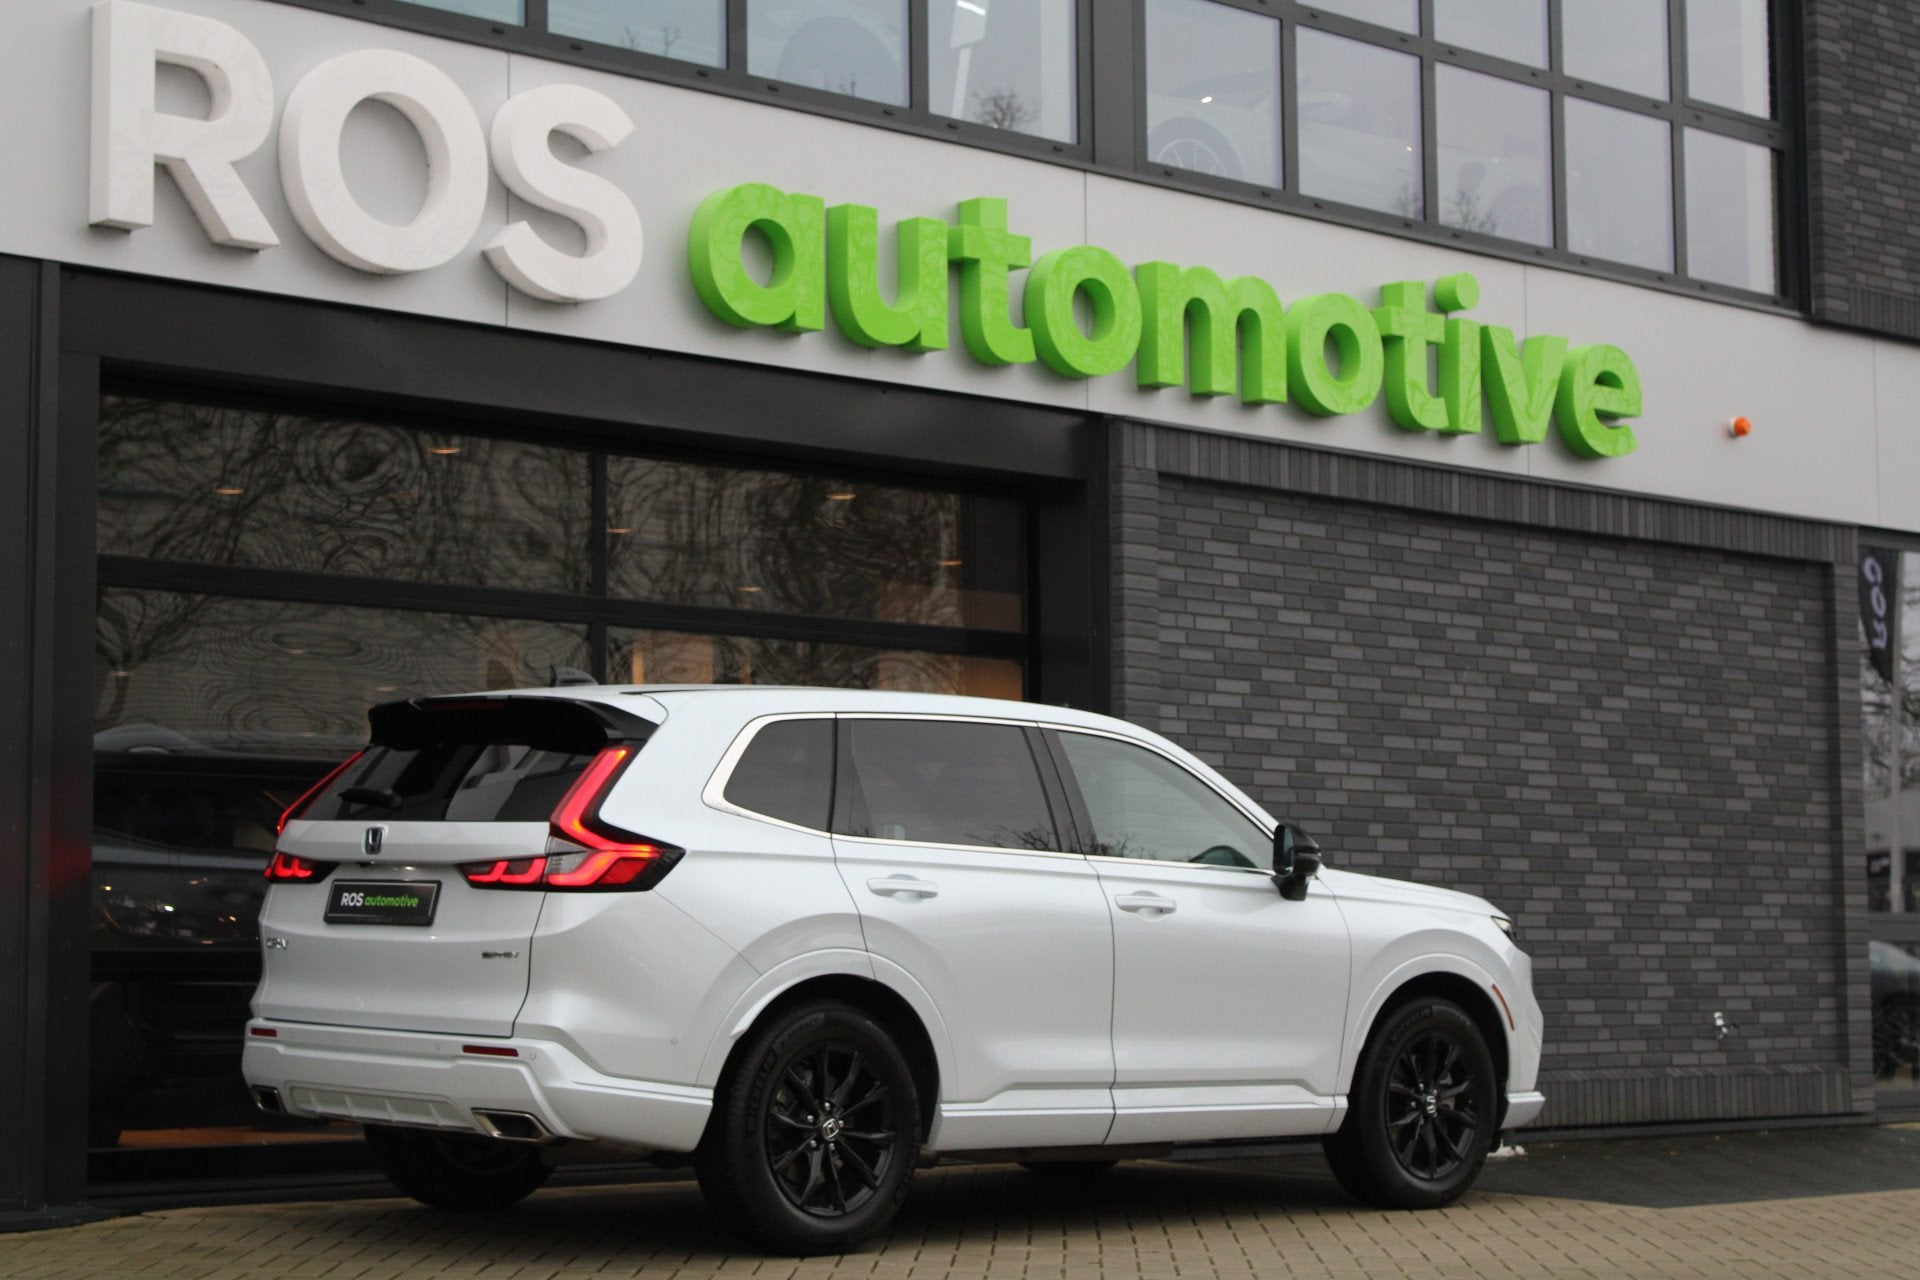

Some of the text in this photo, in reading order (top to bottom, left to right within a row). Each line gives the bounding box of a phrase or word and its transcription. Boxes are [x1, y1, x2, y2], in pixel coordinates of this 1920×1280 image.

[90, 1, 1642, 459] ROS automotive
[341, 892, 419, 907] ROS automotive
